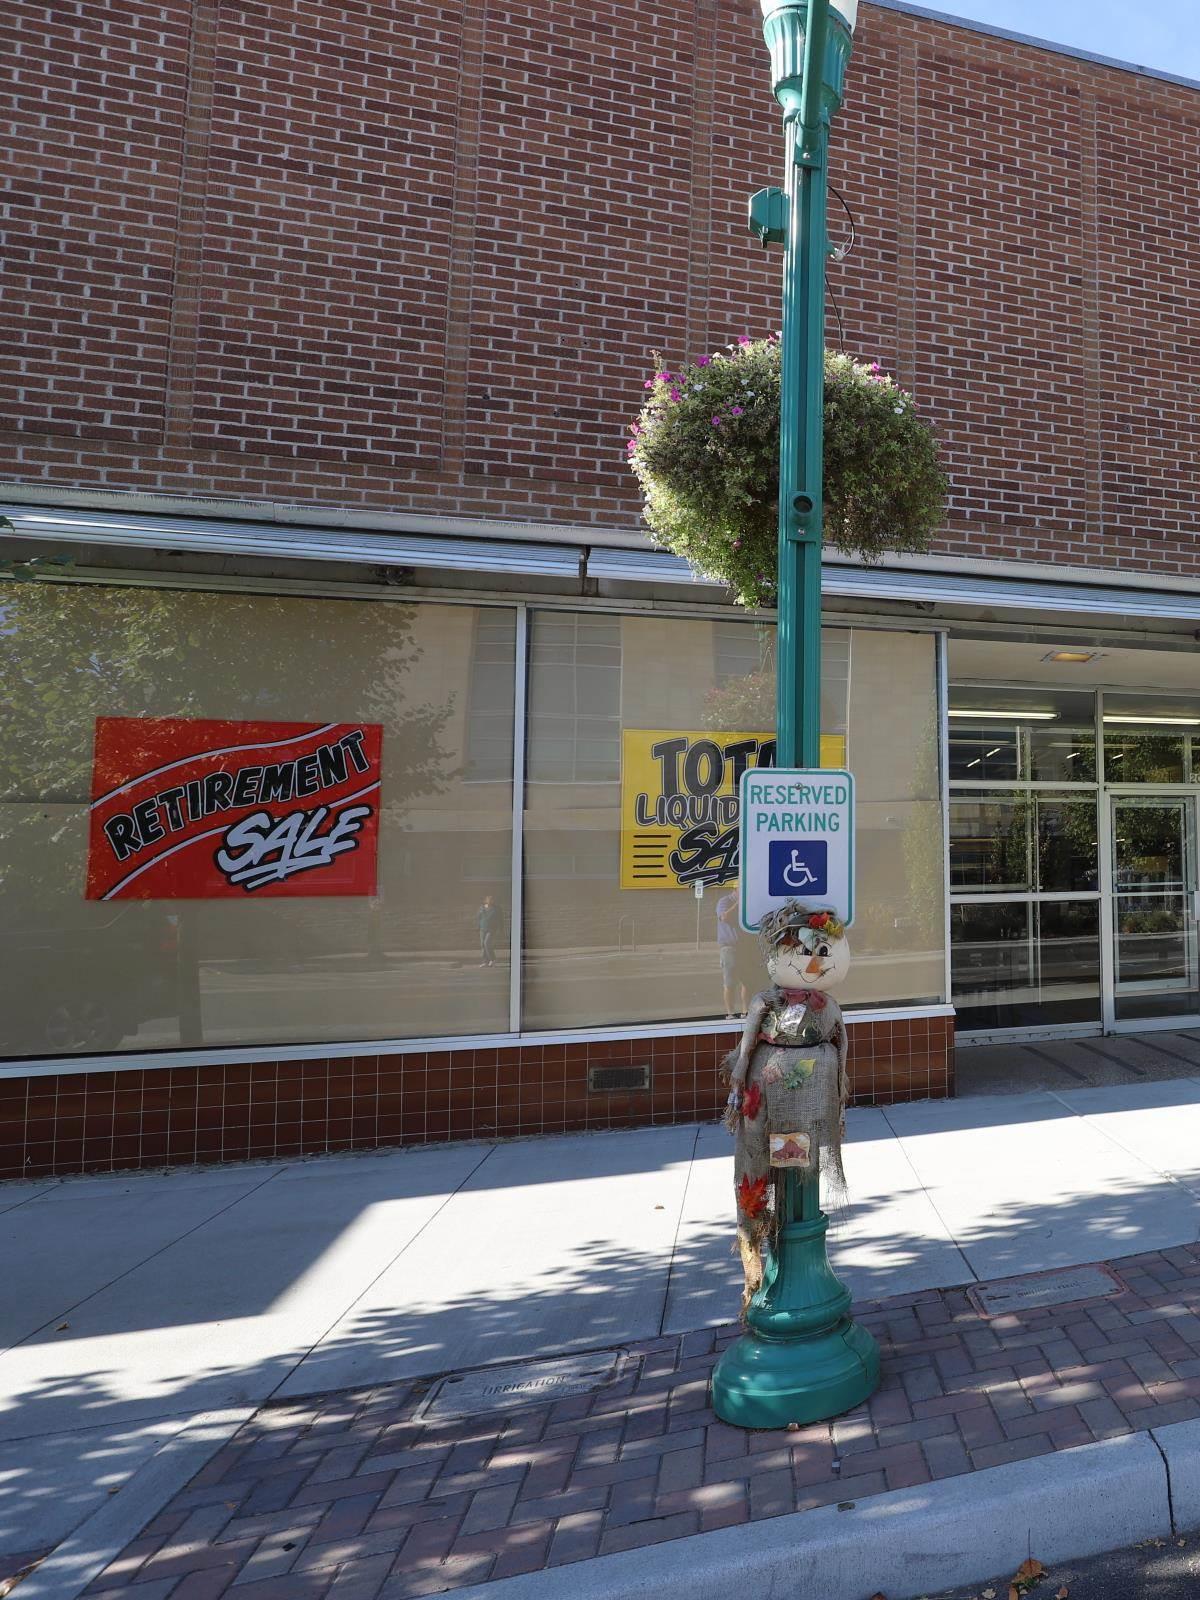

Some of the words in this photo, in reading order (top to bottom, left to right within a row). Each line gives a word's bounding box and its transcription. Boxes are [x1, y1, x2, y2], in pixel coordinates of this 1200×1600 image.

[104, 729, 370, 861] RETIREMENT
[652, 737, 777, 796] TOT
[750, 785, 847, 805] RESERVED
[635, 794, 739, 831] LIQUID
[756, 813, 840, 832] PARKING
[215, 804, 372, 888] SALE
[669, 822, 739, 887] SA
